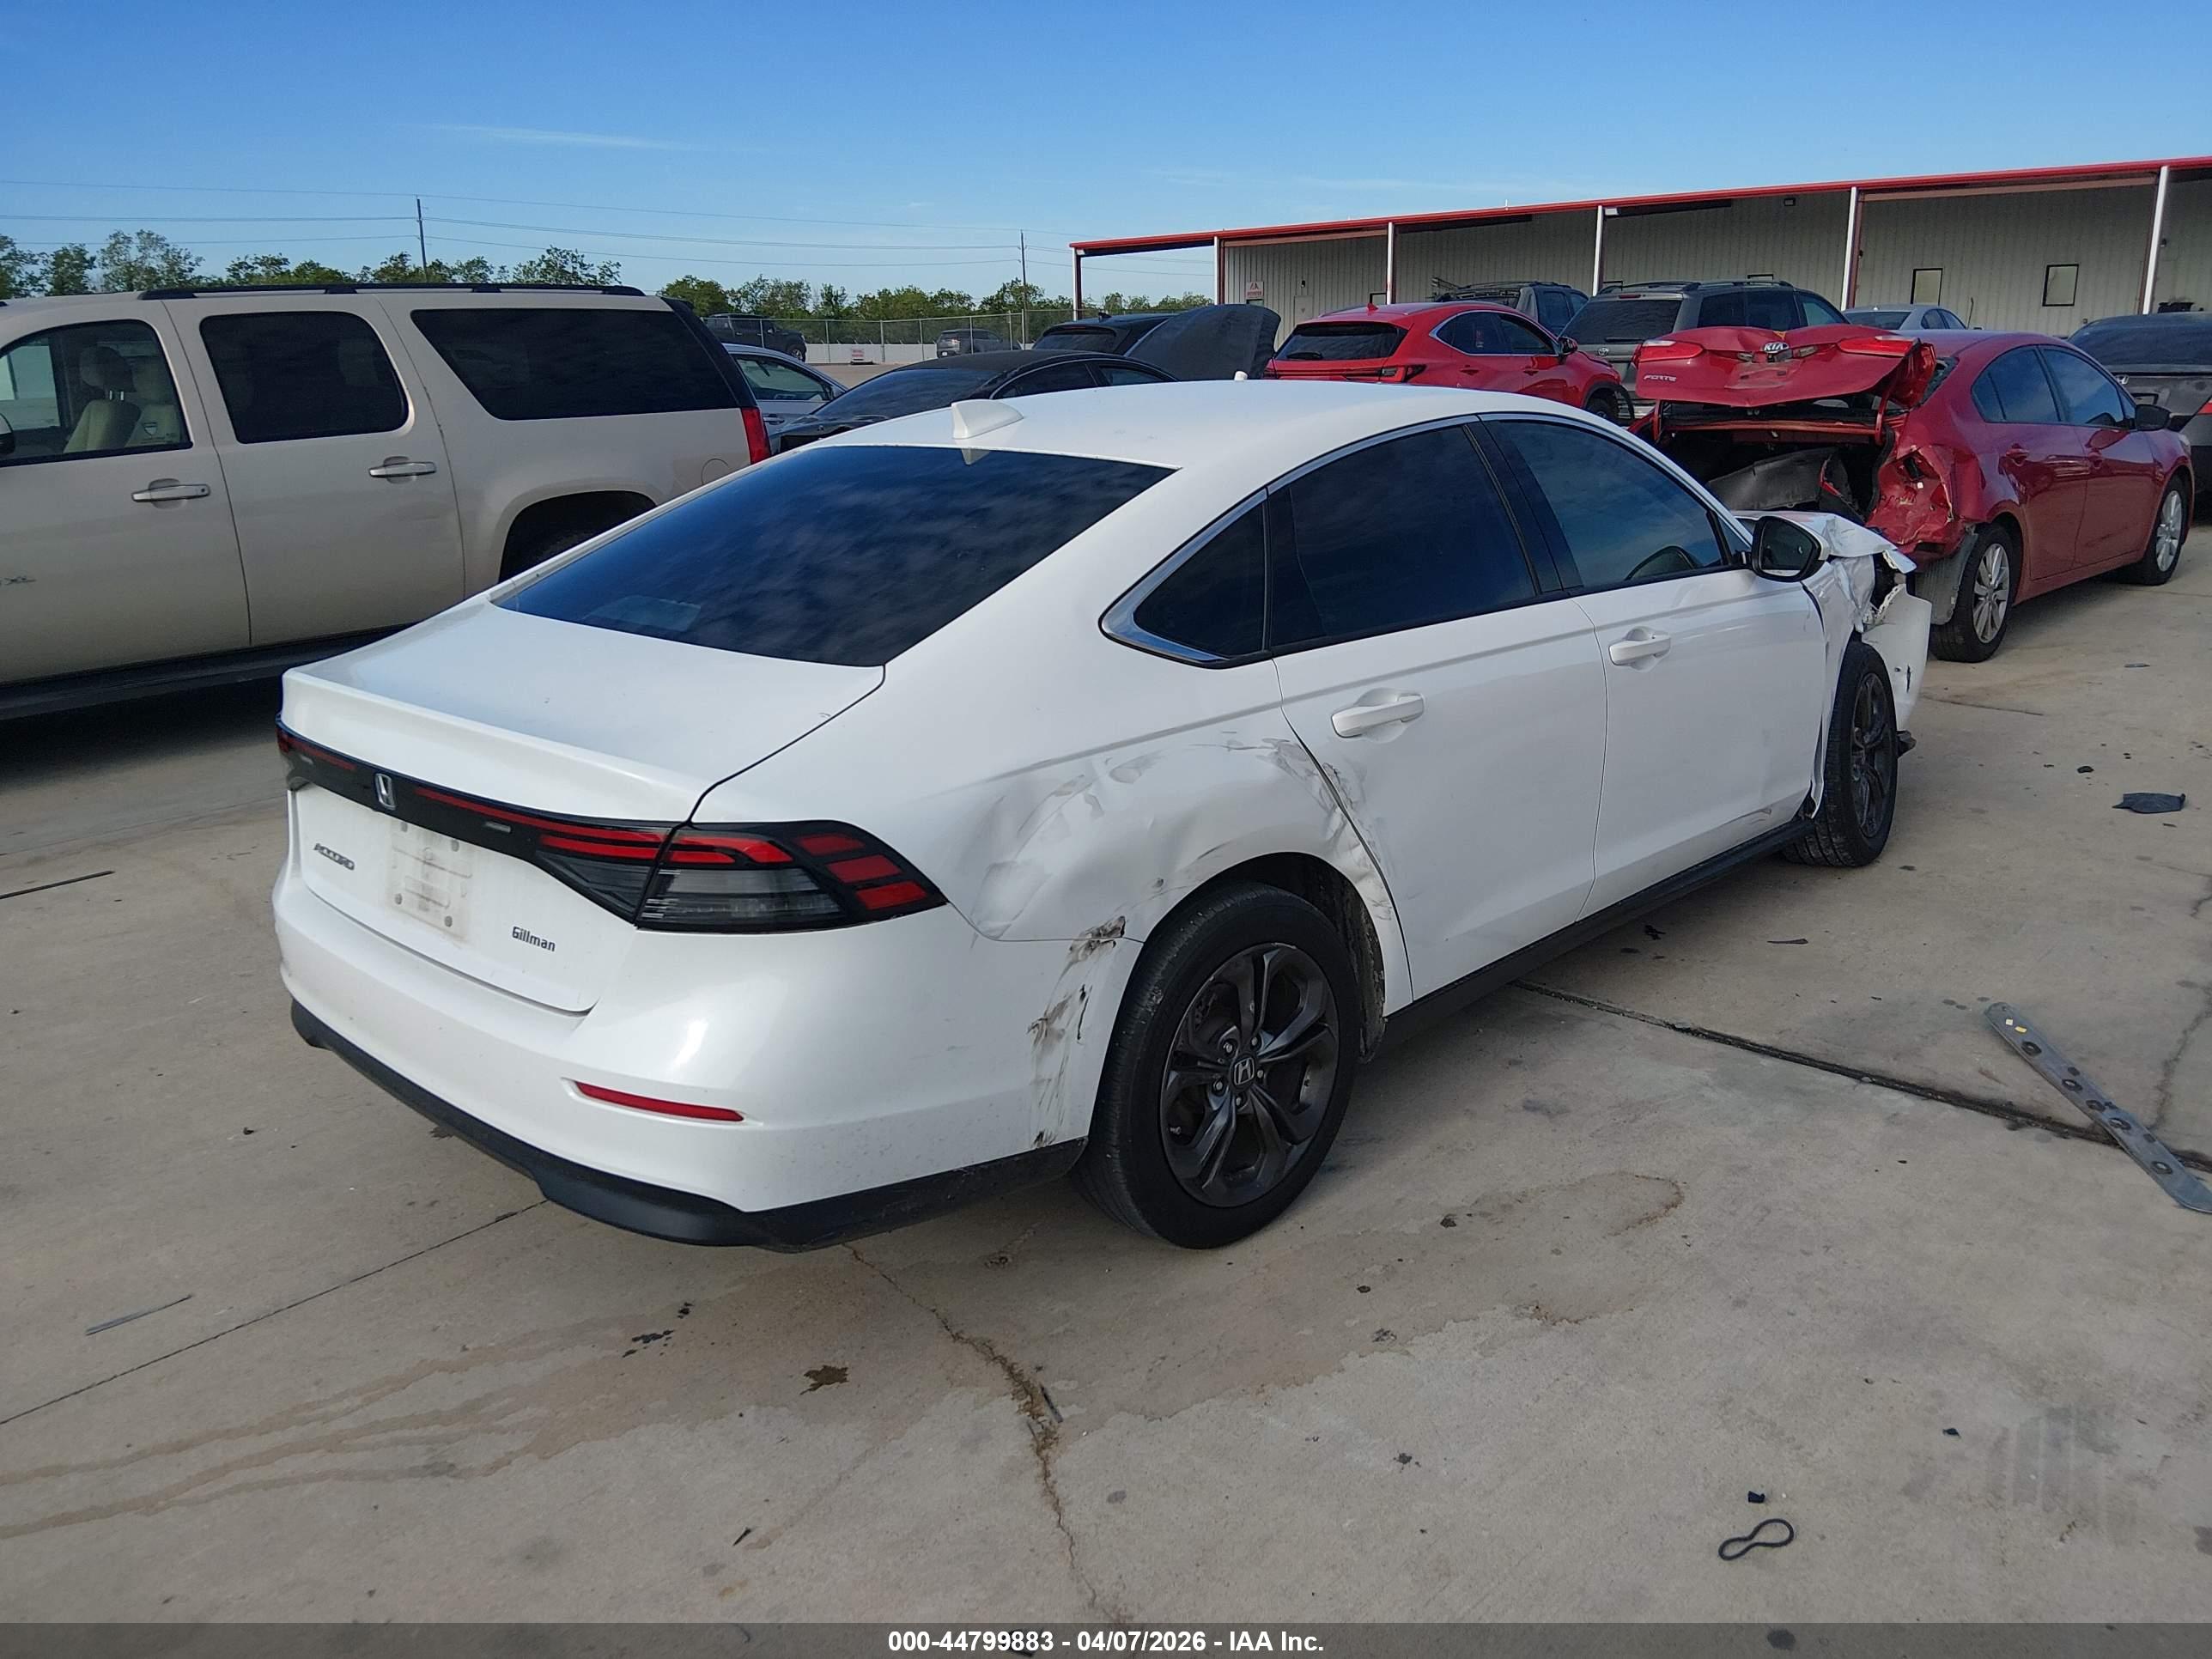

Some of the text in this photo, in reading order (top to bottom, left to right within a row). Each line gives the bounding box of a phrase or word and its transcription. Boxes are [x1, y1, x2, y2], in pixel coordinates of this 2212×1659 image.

[1764, 342, 1789, 353] KIA
[313, 842, 355, 871] ACCORD
[512, 926, 556, 952] Gillman
